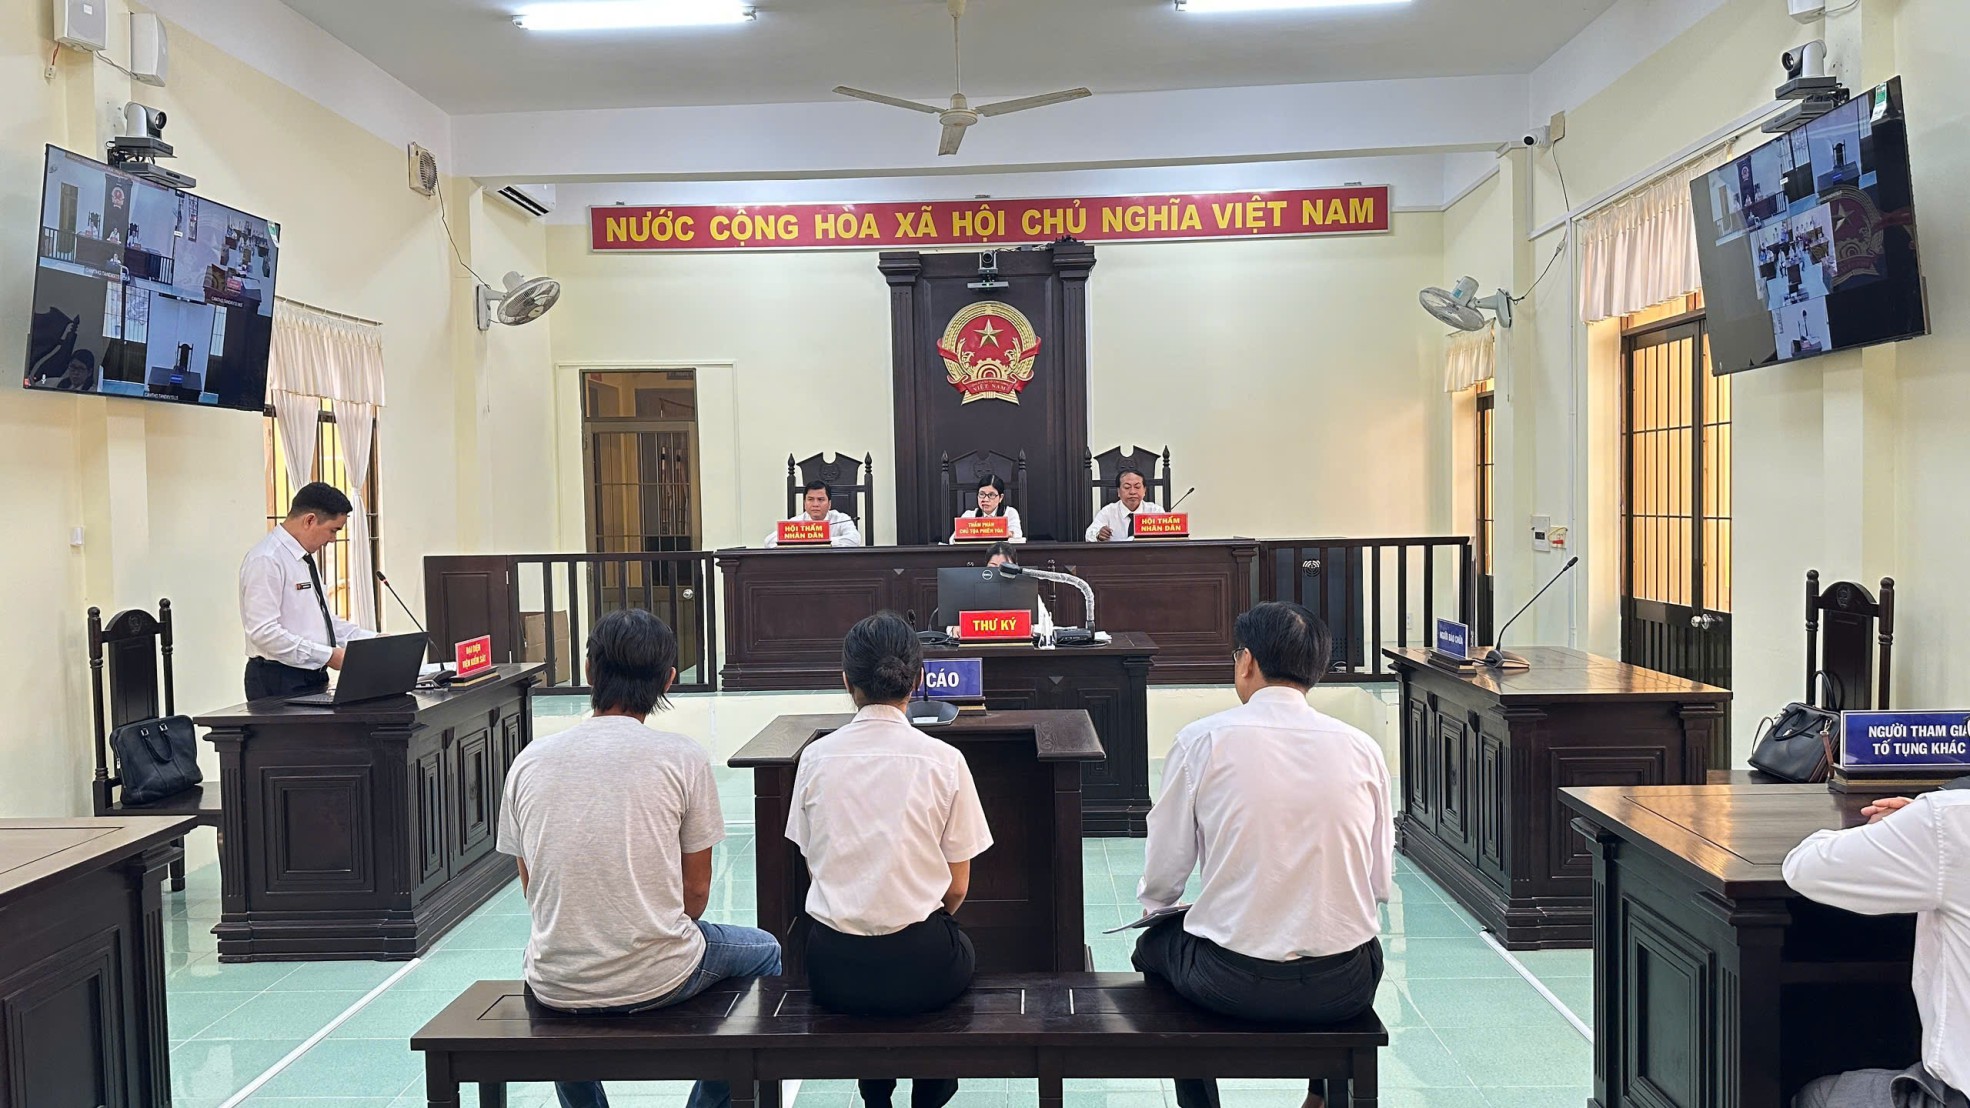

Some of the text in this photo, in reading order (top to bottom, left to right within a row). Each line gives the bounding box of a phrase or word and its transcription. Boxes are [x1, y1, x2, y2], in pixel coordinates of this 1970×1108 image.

[606, 195, 1374, 246] NƯỚC CỘNG HÒA XÃ HỘI CHỦ NGHĨA VIỆT NAM
[784, 524, 799, 532] HỘI
[1141, 517, 1156, 525] HỘI
[784, 531, 824, 539] NHÂN DÂN
[973, 617, 1017, 631] THƯ KÝ
[926, 669, 960, 688] CÁO
[1868, 723, 1907, 738] NGƯỜI
[1910, 725, 1947, 737] THAM
[1872, 739, 1967, 757] TỐ TỤNG KHÁC
